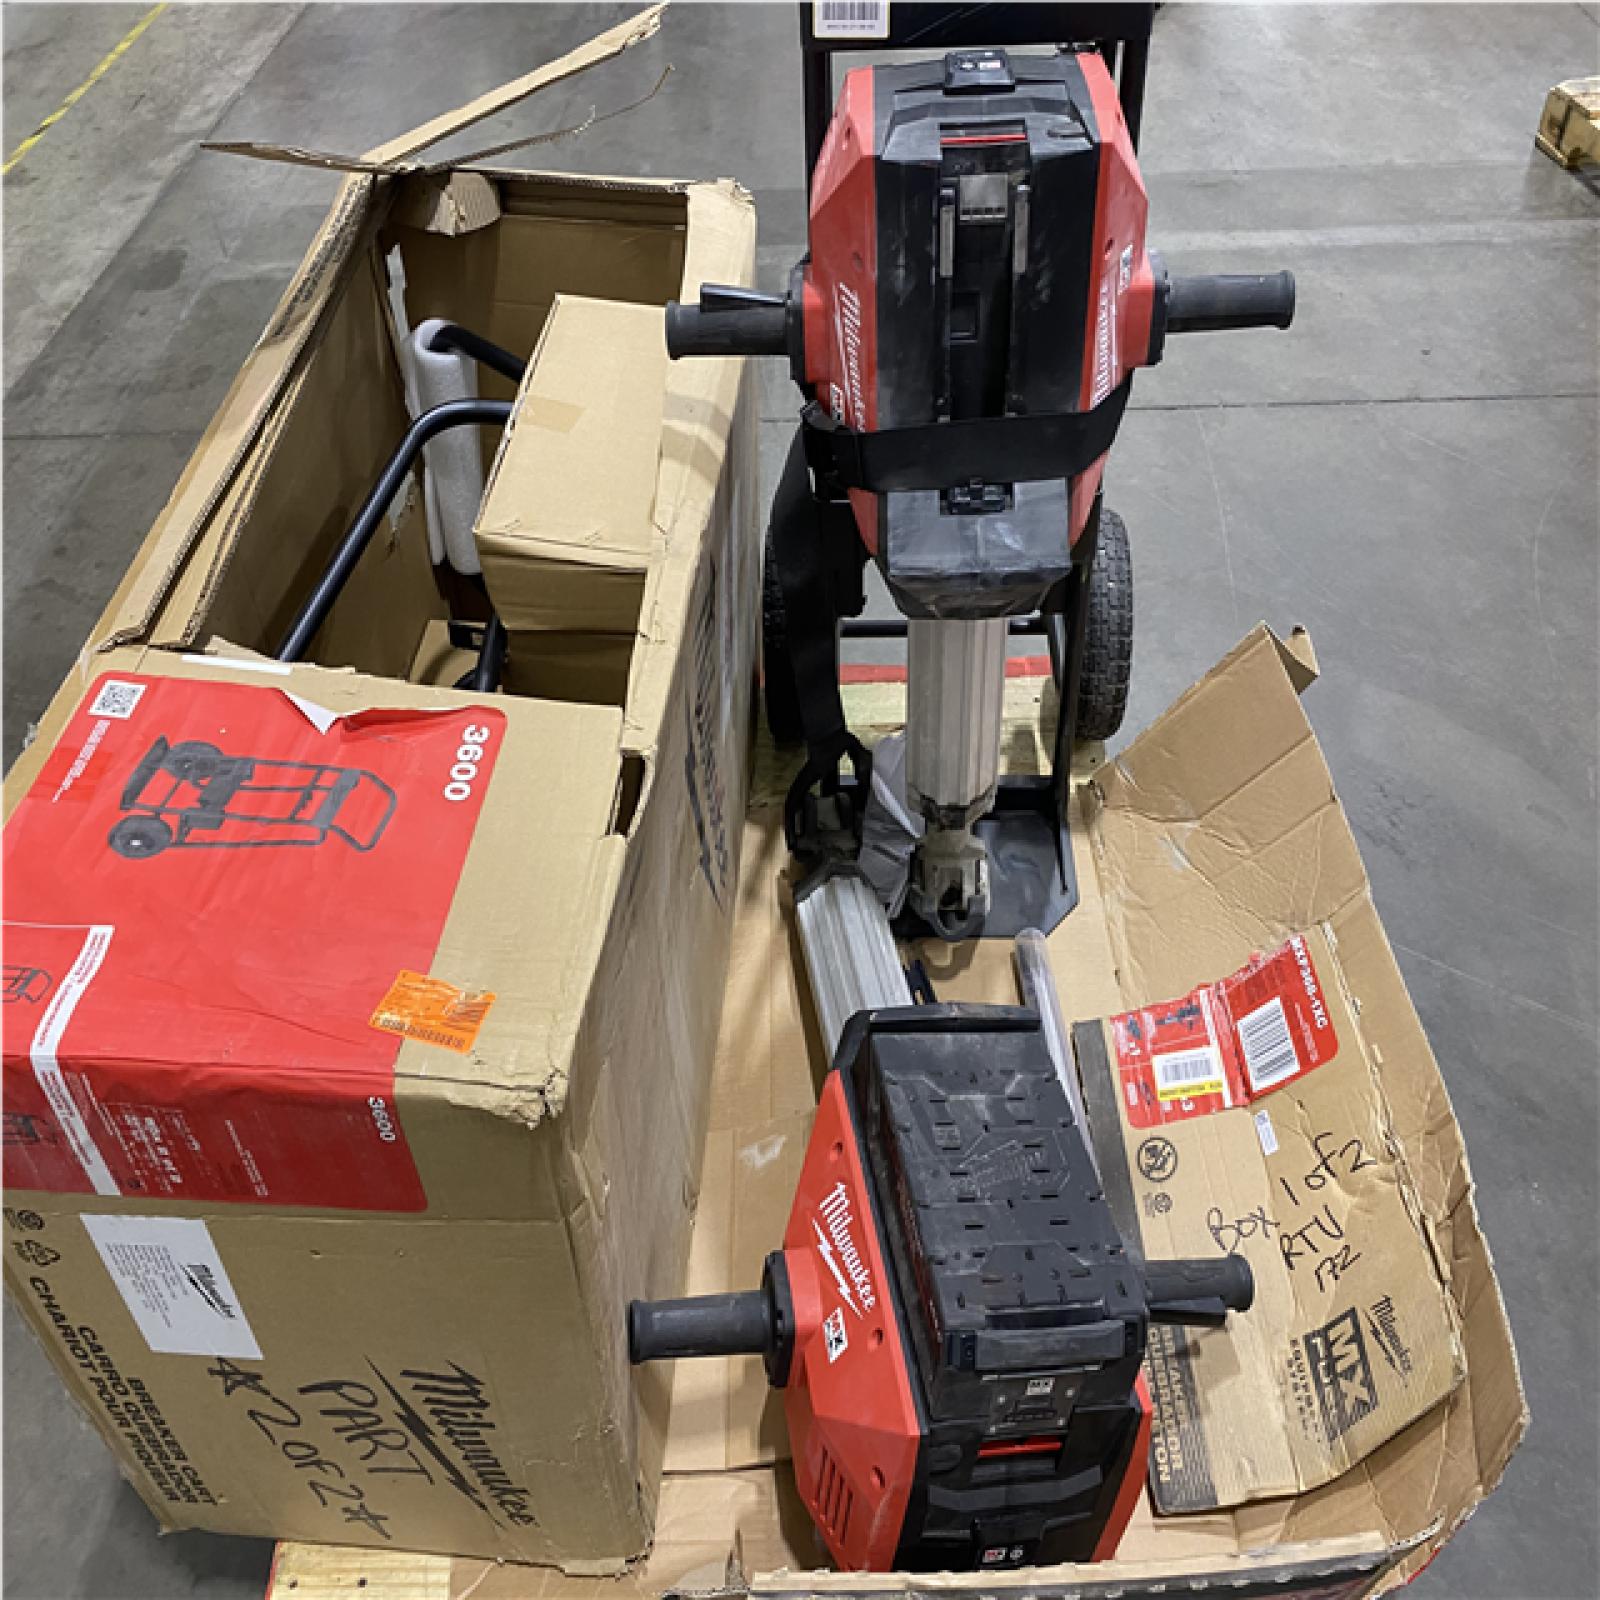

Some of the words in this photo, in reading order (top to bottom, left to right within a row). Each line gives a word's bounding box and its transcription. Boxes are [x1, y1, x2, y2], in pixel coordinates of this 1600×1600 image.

[443, 724, 489, 801] 3600
[368, 1096, 396, 1142] 3600
[1279, 1176, 1301, 1206] 1
[1339, 1139, 1378, 1173] 2
[819, 1182, 876, 1312] Milwaukee
[30, 1276, 99, 1374] CHARIOT
[88, 1376, 132, 1428] POUR
[79, 1325, 130, 1395] CARRO
[1328, 1317, 1371, 1415] MX
[1370, 1295, 1412, 1371] Milwaukee
[127, 1376, 188, 1461] BREAKER
[182, 1464, 218, 1506] CART
[248, 1395, 302, 1446] 2
[308, 1480, 366, 1508] 2
[298, 1380, 436, 1485] PART
[400, 1359, 541, 1528] Milwaukee
